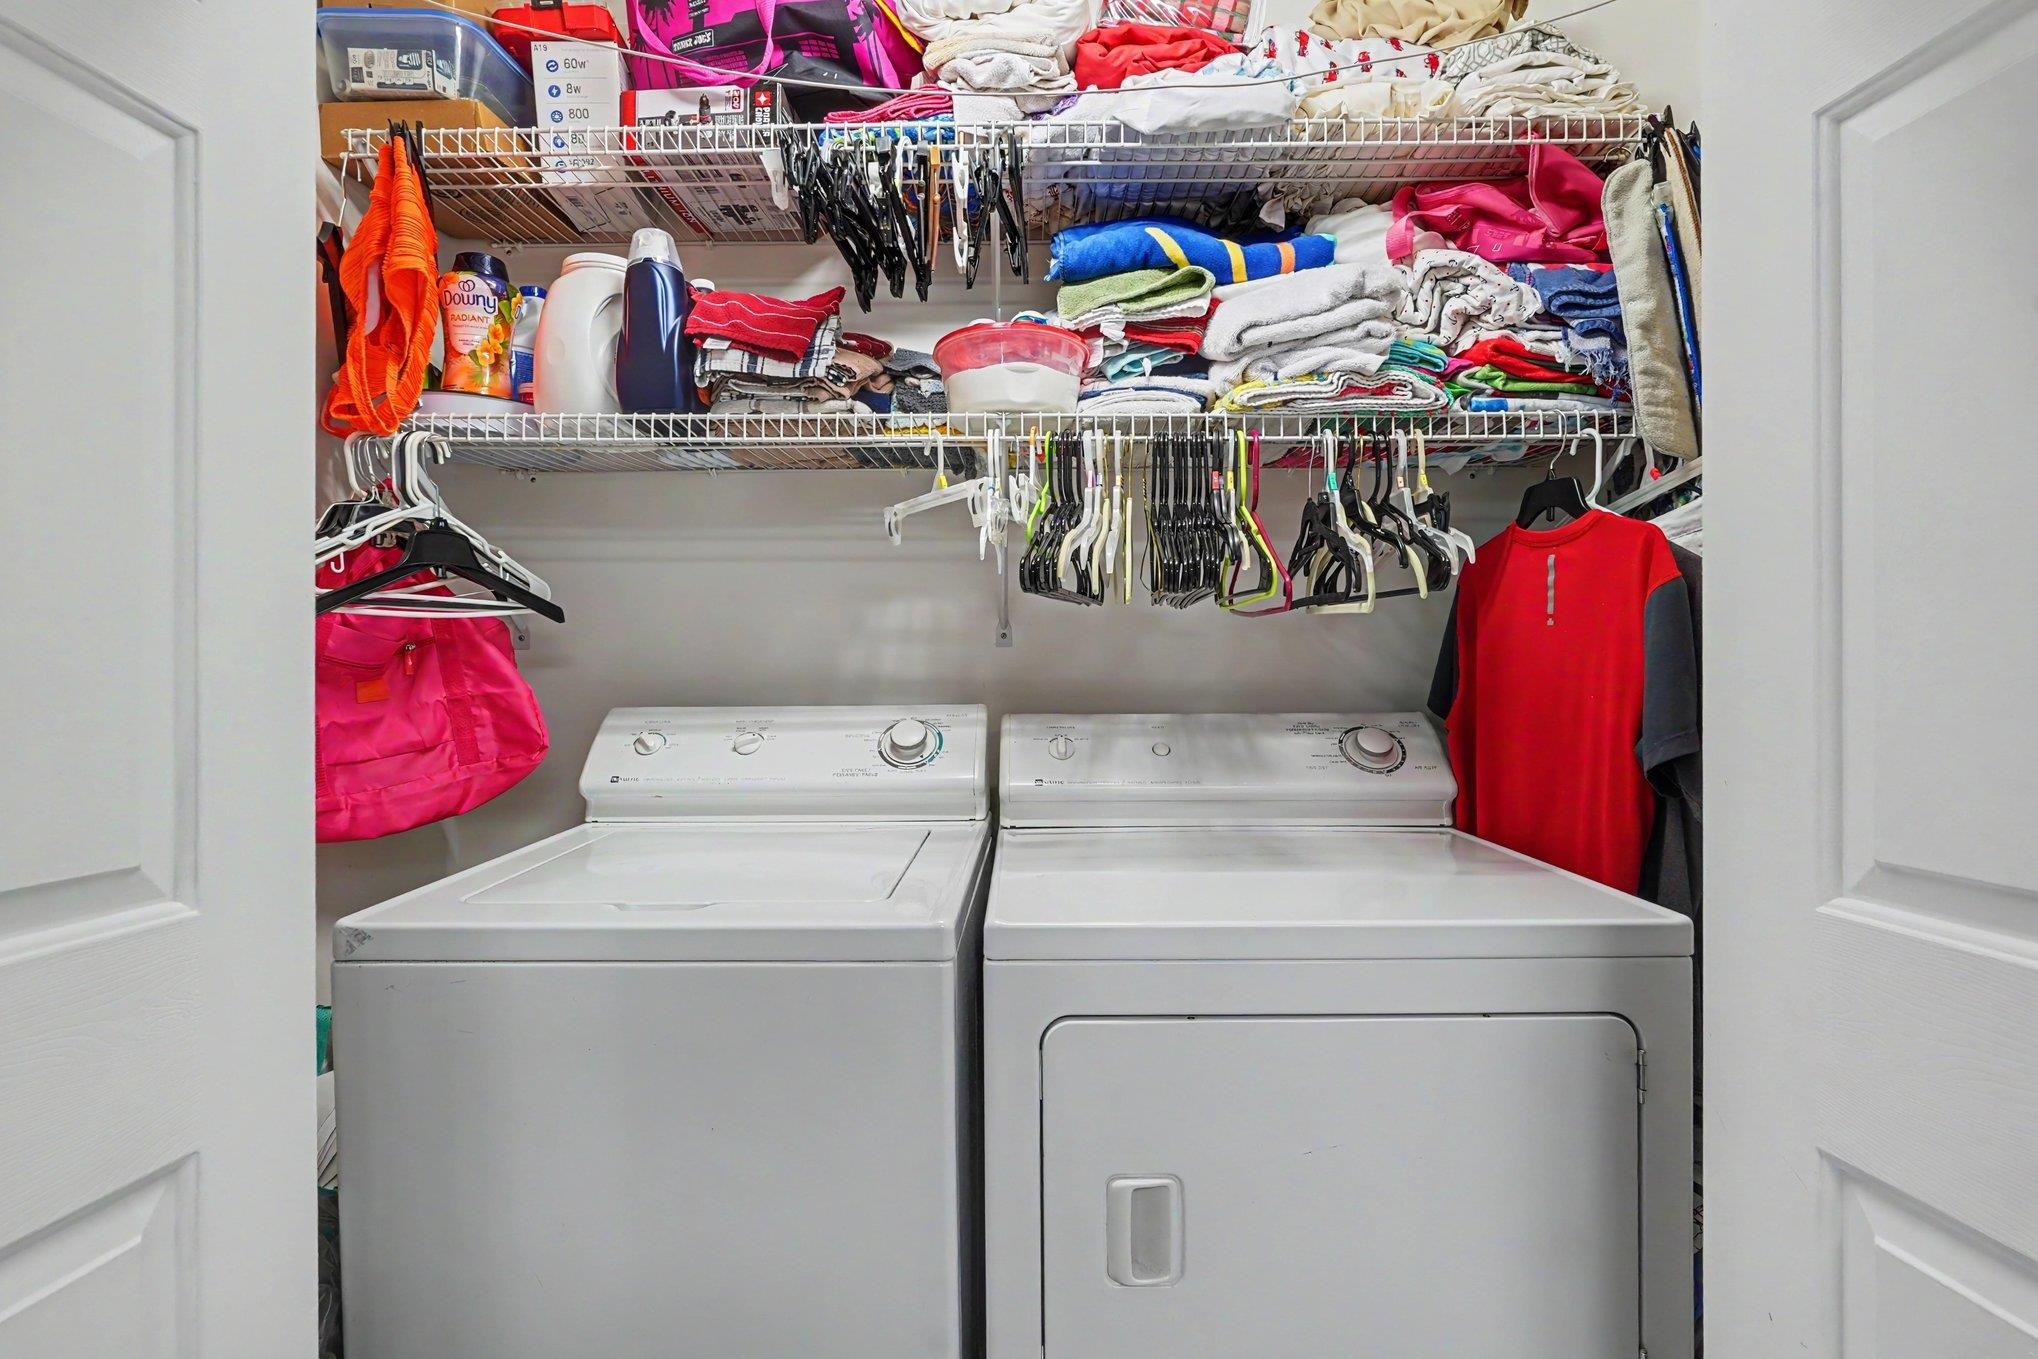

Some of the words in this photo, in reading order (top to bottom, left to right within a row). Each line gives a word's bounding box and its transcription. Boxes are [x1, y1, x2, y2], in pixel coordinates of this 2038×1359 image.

[533, 44, 548, 52] A19
[568, 108, 590, 119] 800
[443, 290, 497, 315] Downy
[450, 314, 491, 324] RADIANT
